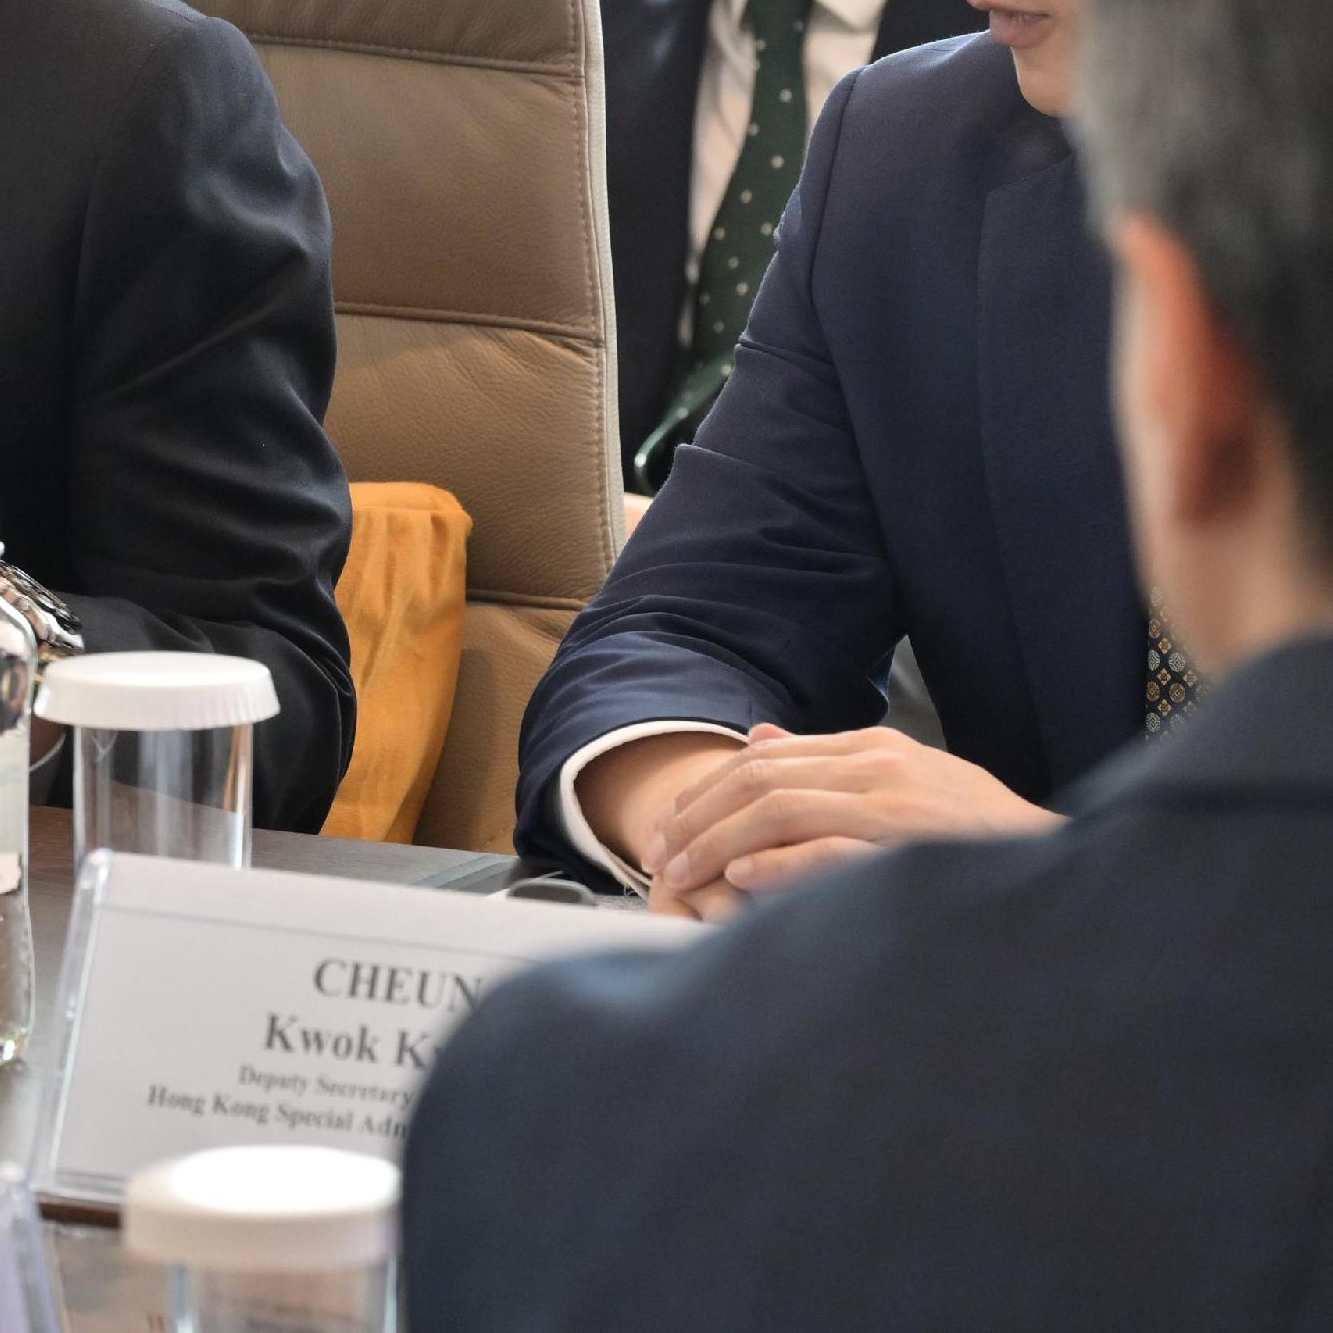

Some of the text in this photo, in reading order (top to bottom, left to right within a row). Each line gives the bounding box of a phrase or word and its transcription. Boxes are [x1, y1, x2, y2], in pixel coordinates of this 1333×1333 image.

[313, 957, 480, 1011] CHEUN
[263, 1012, 379, 1064] Kwok
[148, 1084, 206, 1117] Hong
[211, 1093, 271, 1125] Kong
[276, 1102, 354, 1132] Special
[238, 1063, 414, 1111] Deputy Secretary
